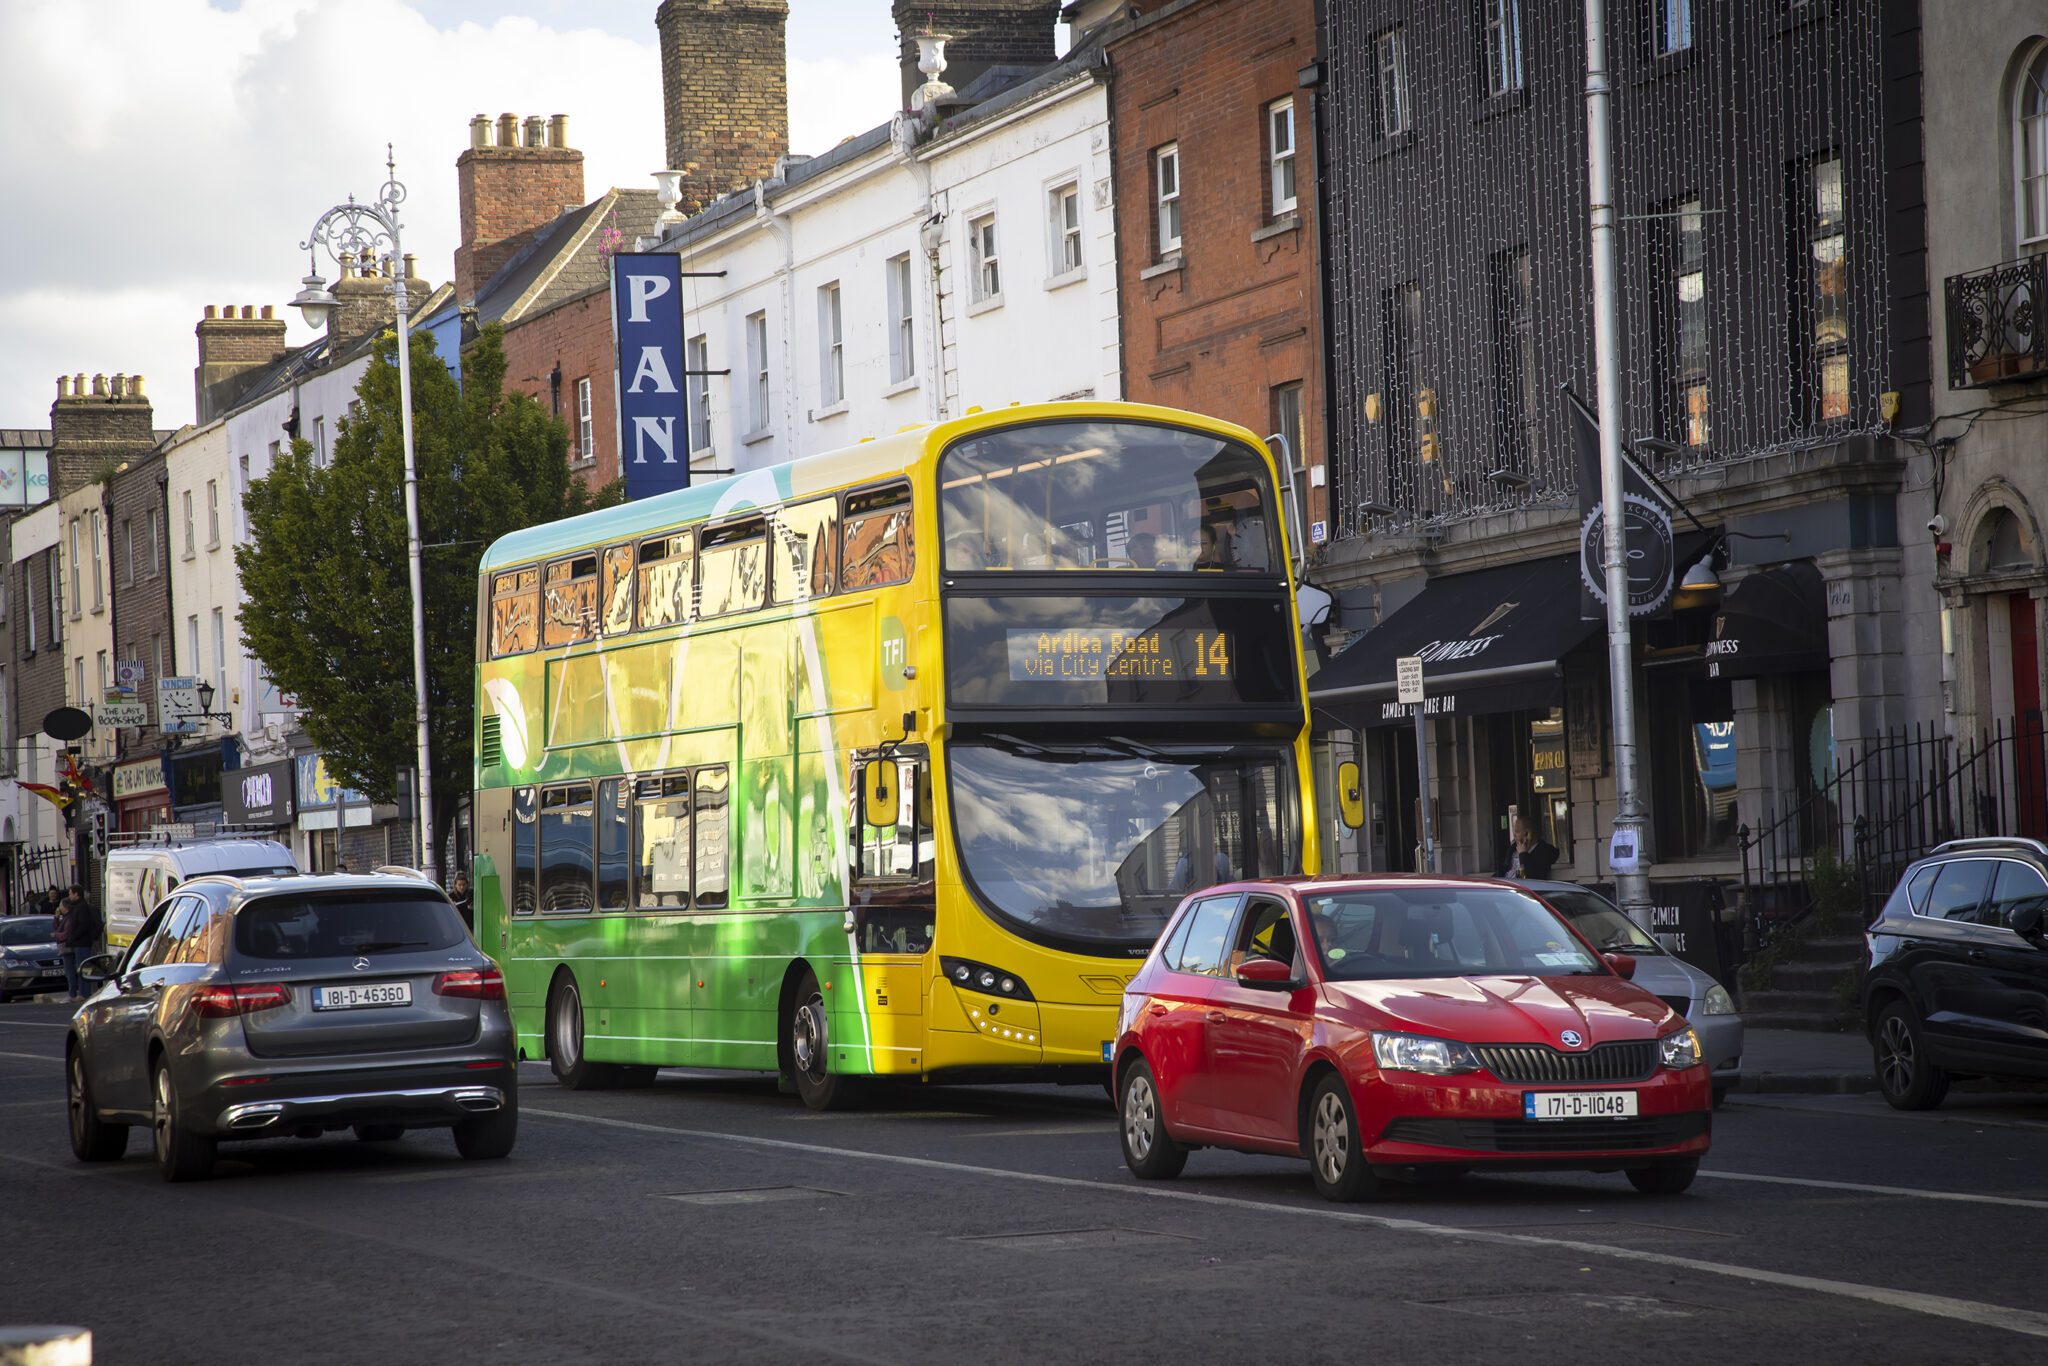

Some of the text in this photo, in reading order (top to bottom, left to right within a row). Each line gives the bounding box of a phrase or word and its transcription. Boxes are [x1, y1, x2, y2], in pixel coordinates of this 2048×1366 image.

[625, 275, 679, 464] PAN
[1627, 504, 1670, 544] XCHANGE
[883, 638, 904, 666] TFI
[1037, 632, 1229, 675] Ardlea Road 14
[1025, 655, 1172, 675] via City Centre
[161, 679, 194, 689] LYNCHS
[104, 707, 141, 715] THE LAST
[1382, 695, 1456, 719] CAMDEN EANGE BAR
[164, 721, 197, 732] TAIRS
[145, 764, 166, 786] BOOKSHO
[1652, 906, 1680, 926] CMEN
[328, 986, 404, 1006] 181-D-46360
[1548, 1096, 1624, 1116] 171-D-11048
